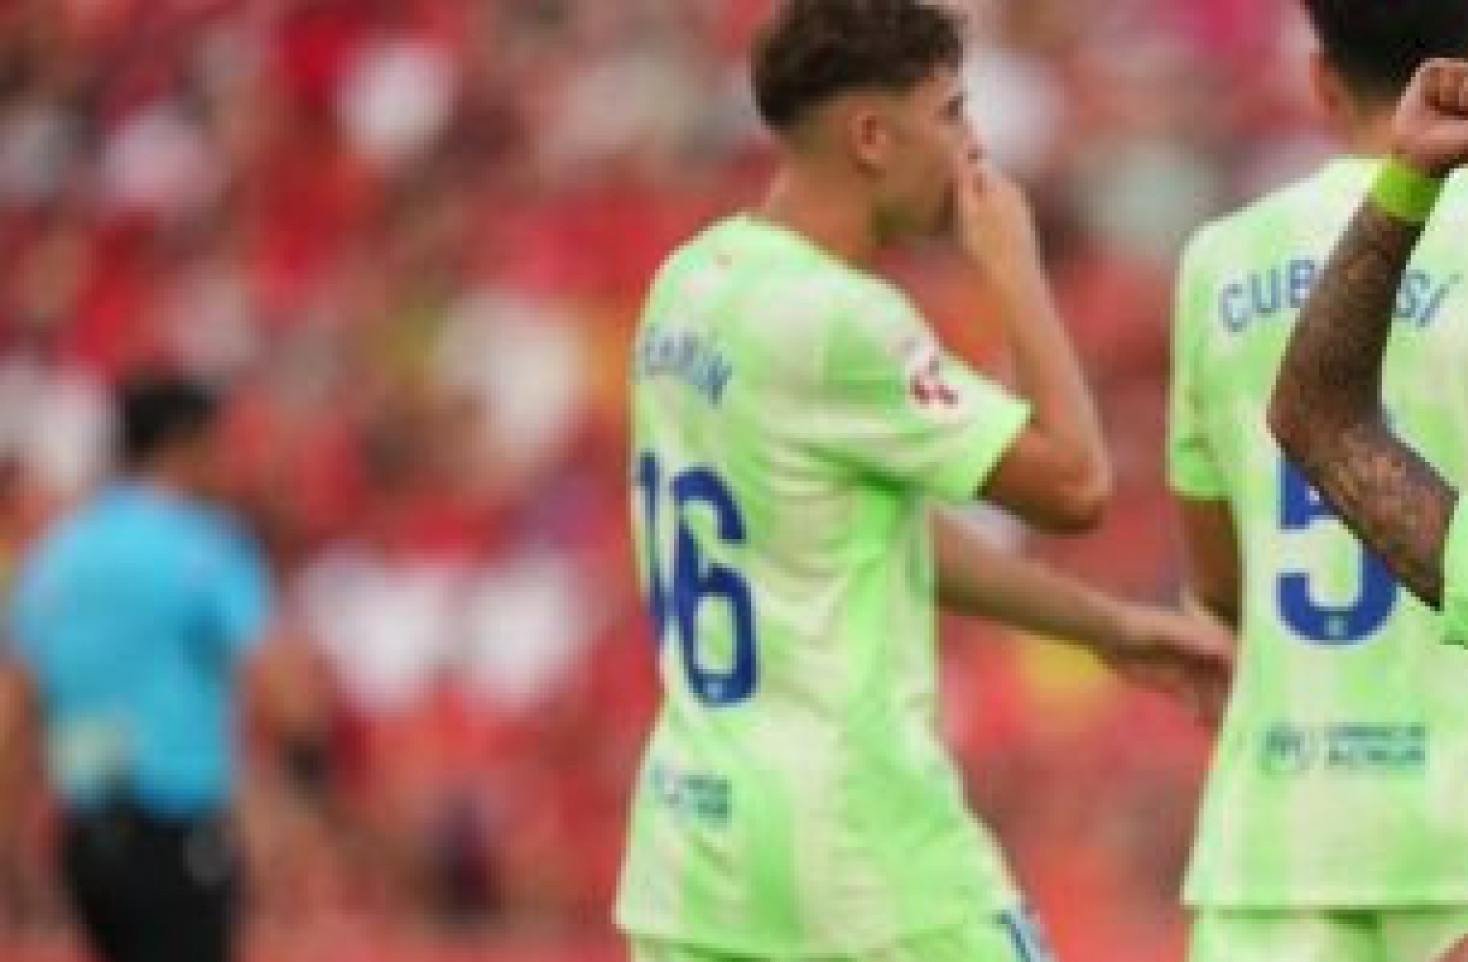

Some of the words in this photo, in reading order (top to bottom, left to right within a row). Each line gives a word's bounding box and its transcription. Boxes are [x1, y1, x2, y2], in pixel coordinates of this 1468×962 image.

[1218, 258, 1463, 333] CUBSÍ
[637, 448, 758, 709] 16
[1273, 455, 1400, 647] 5
